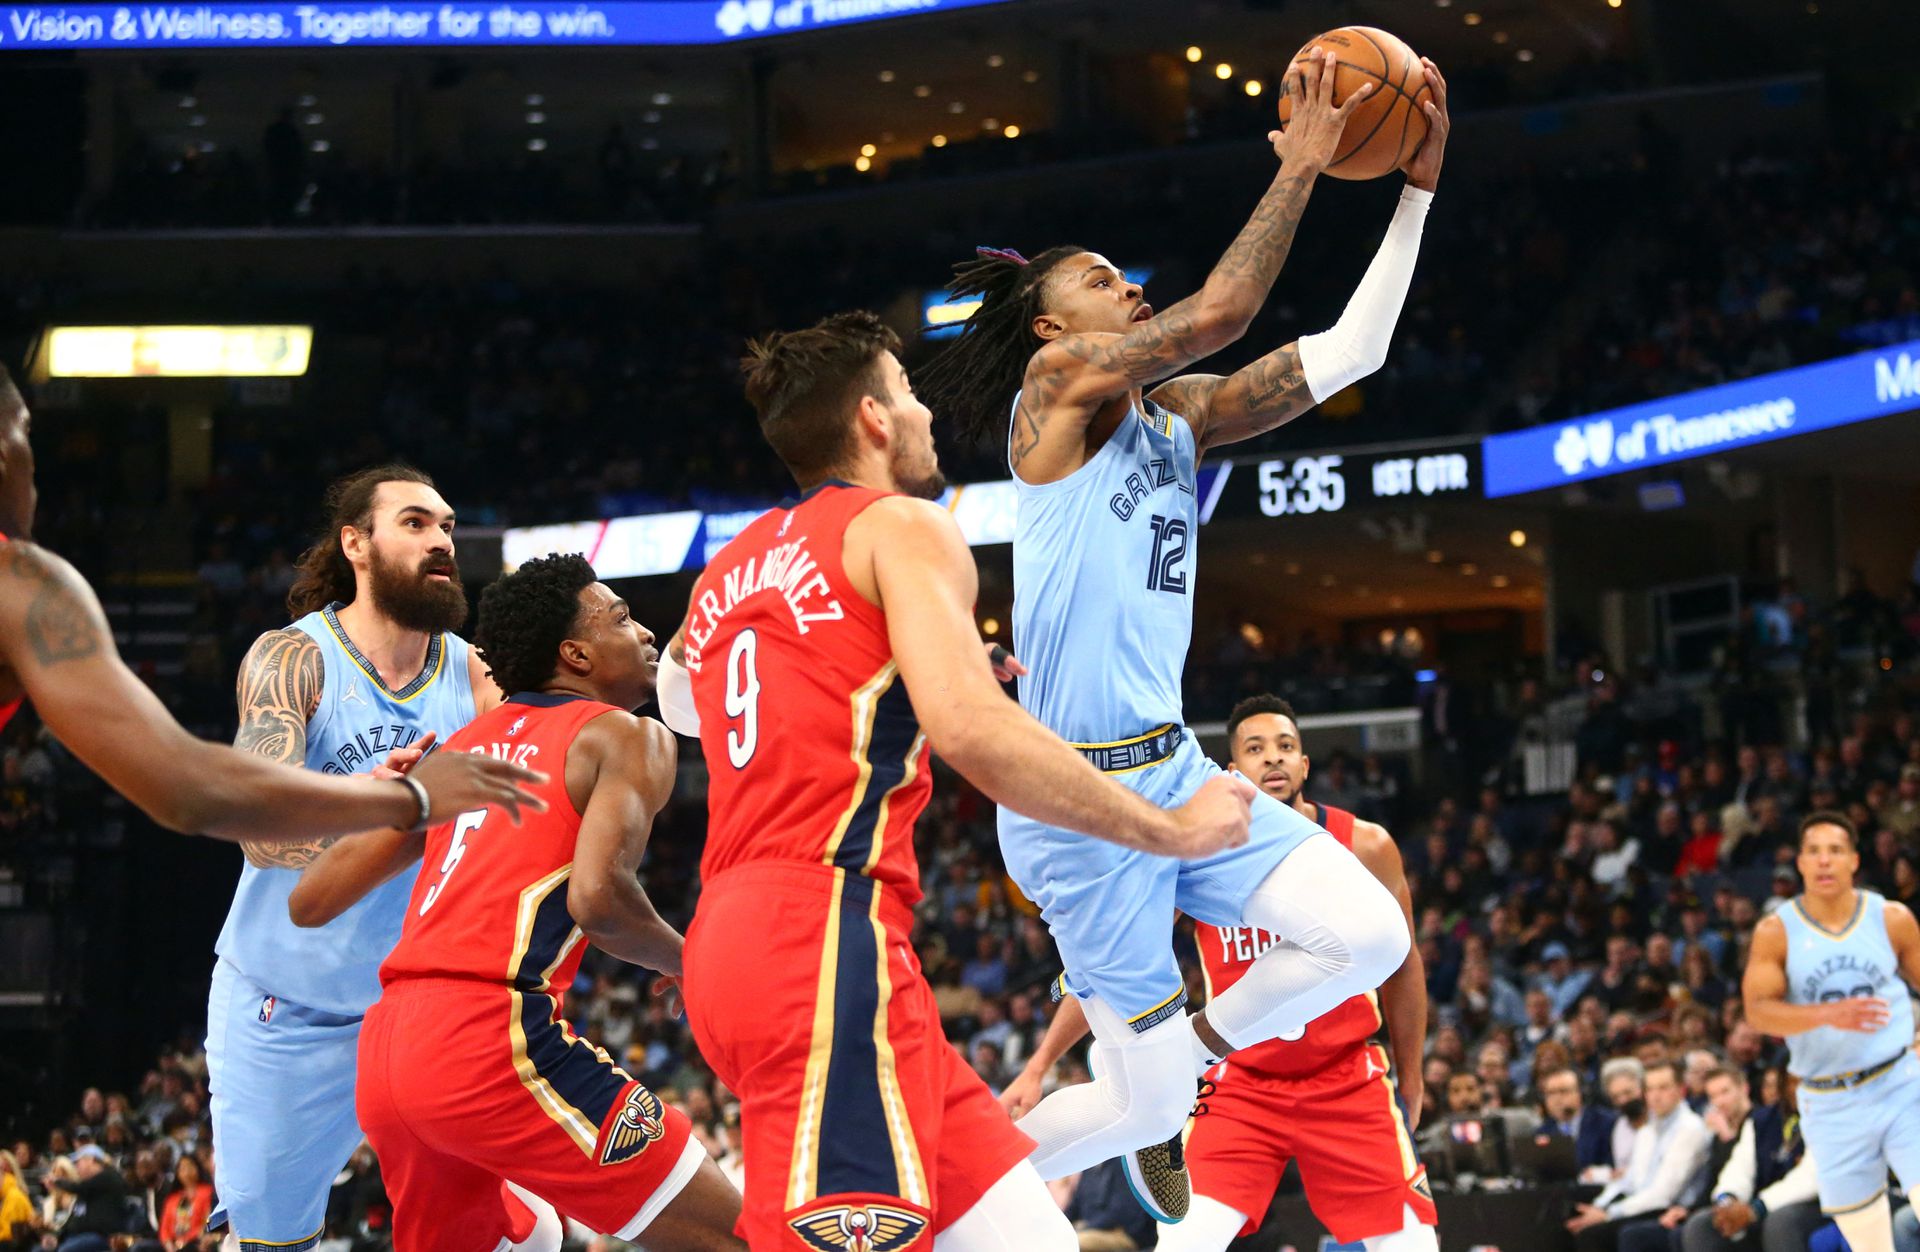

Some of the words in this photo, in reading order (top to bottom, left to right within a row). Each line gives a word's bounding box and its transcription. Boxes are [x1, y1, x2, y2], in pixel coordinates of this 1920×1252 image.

[9, 8, 103, 41] Vision
[110, 7, 139, 41] &
[141, 7, 292, 41] Wellness.
[294, 5, 432, 44] Together
[438, 3, 483, 38] for
[489, 6, 542, 38] the
[546, 4, 615, 38] win.
[1615, 419, 1648, 463] of
[1650, 396, 1796, 455] Tennessee
[1258, 454, 1345, 517] 5:35
[1372, 458, 1414, 497] 1ST
[1415, 453, 1468, 496] QTR
[1147, 514, 1187, 595] 12
[725, 626, 761, 771] 9
[419, 808, 488, 917] 5
